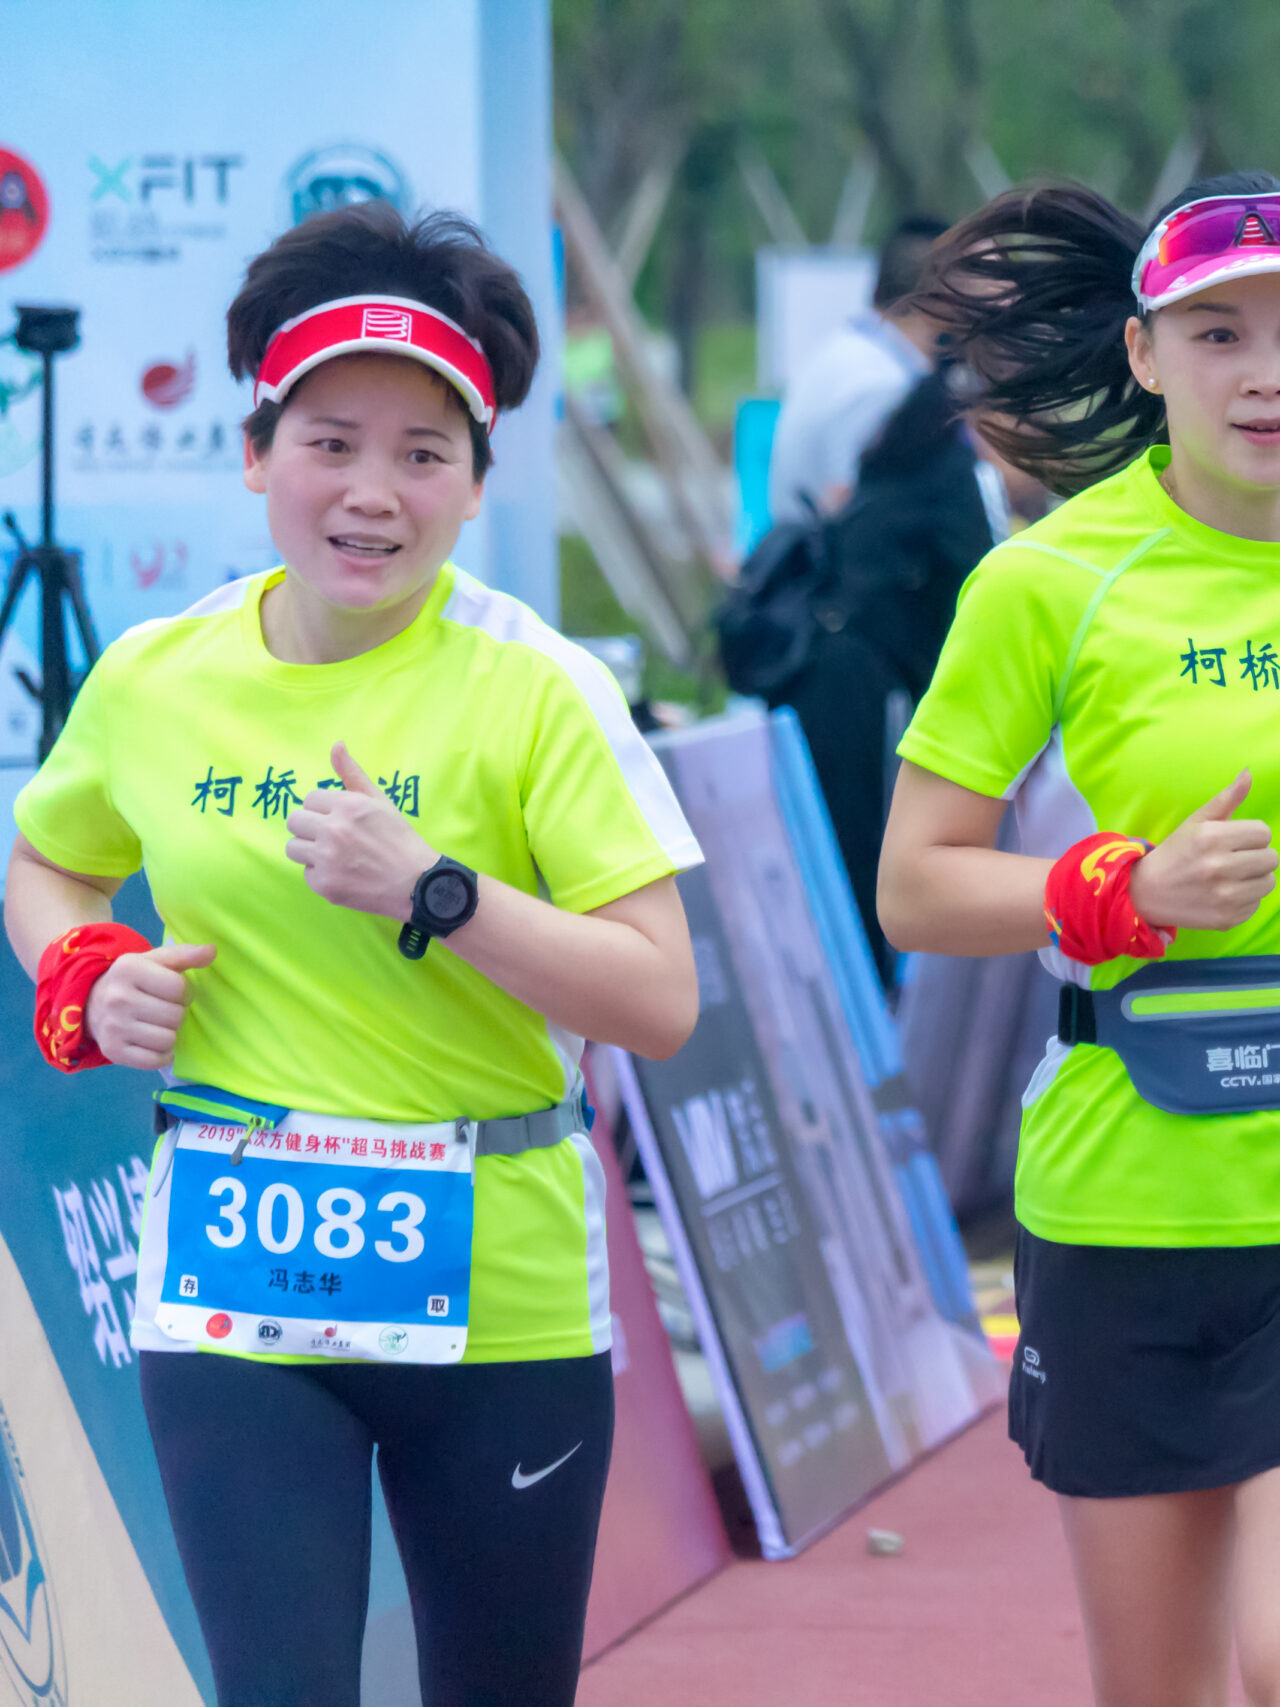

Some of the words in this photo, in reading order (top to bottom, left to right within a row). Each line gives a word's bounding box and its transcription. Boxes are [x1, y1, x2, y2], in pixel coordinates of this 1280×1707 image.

[88, 154, 245, 206] XFIT
[191, 766, 420, 820] 柯桥湖
[205, 1176, 427, 1263] 3083
[182, 1279, 196, 1294] 存
[267, 1268, 343, 1297] 冯志华
[431, 1298, 446, 1313] 取
